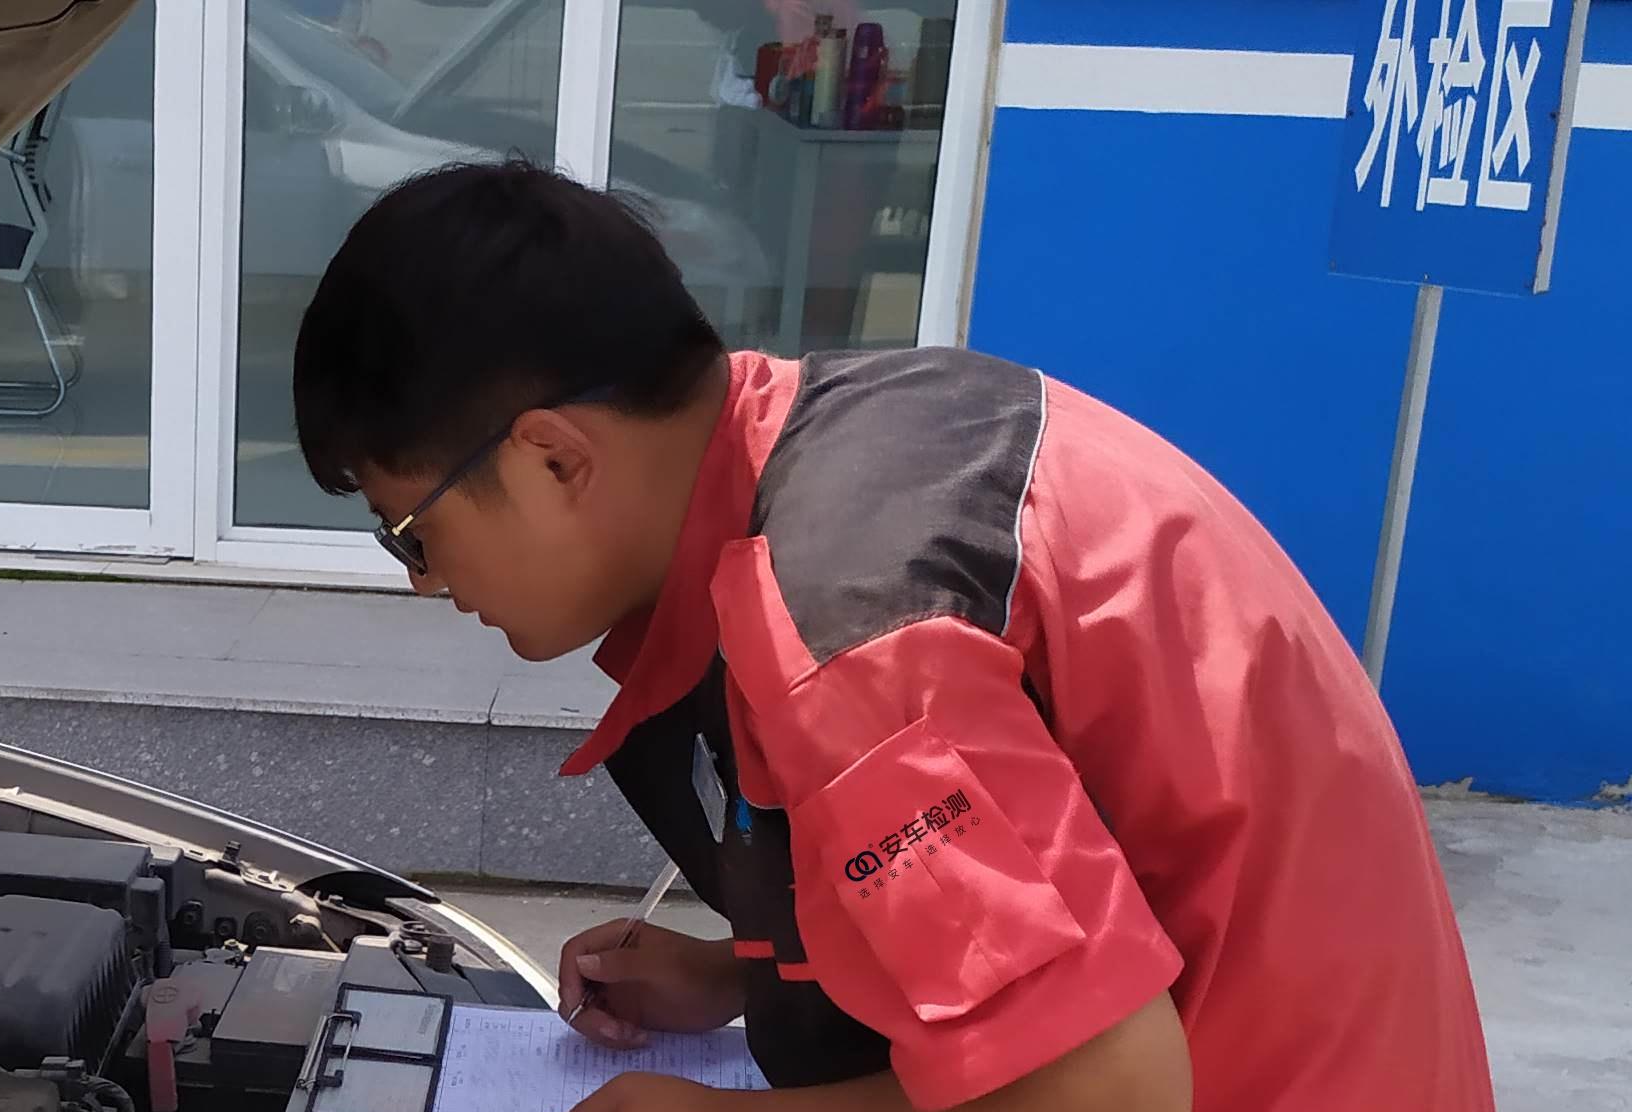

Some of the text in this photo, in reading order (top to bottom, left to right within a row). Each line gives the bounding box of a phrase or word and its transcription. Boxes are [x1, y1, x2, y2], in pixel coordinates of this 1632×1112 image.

[1354, 0, 1552, 212] 外检区
[858, 816, 981, 899] 选择安车 选择放心
[878, 788, 972, 863] 安车检测
